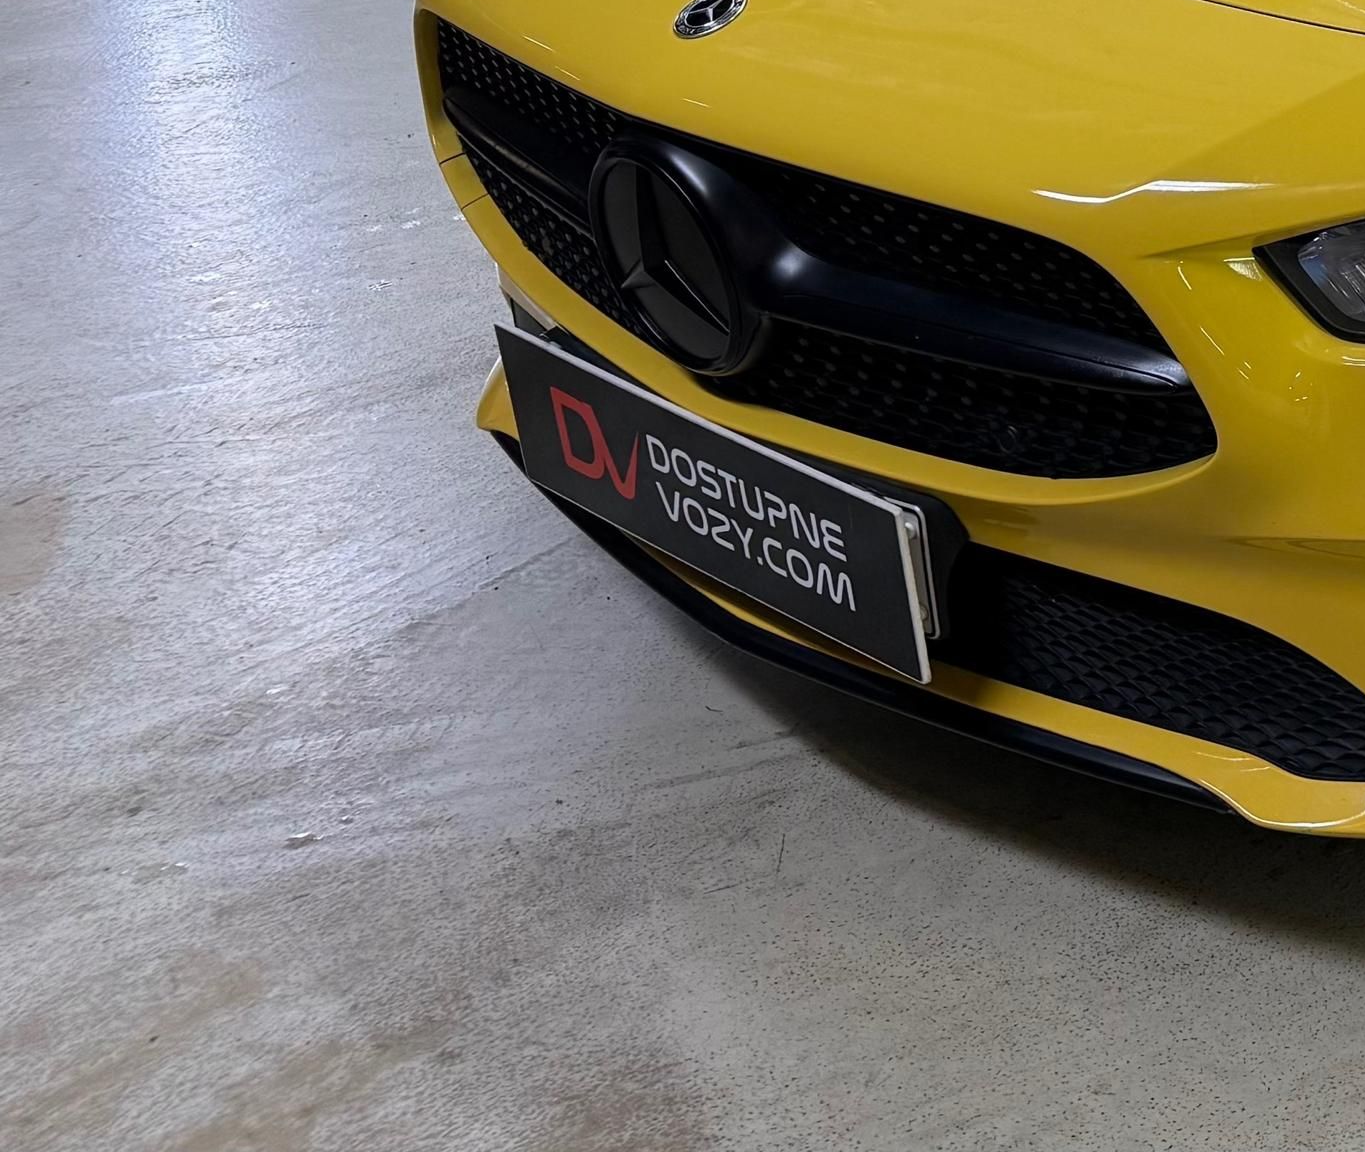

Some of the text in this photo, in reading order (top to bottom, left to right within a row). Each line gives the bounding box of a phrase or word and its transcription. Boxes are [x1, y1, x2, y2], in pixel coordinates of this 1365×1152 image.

[549, 386, 639, 500] DV
[645, 433, 848, 562] DOSTUPNE
[655, 481, 857, 612] VOZY.COM
